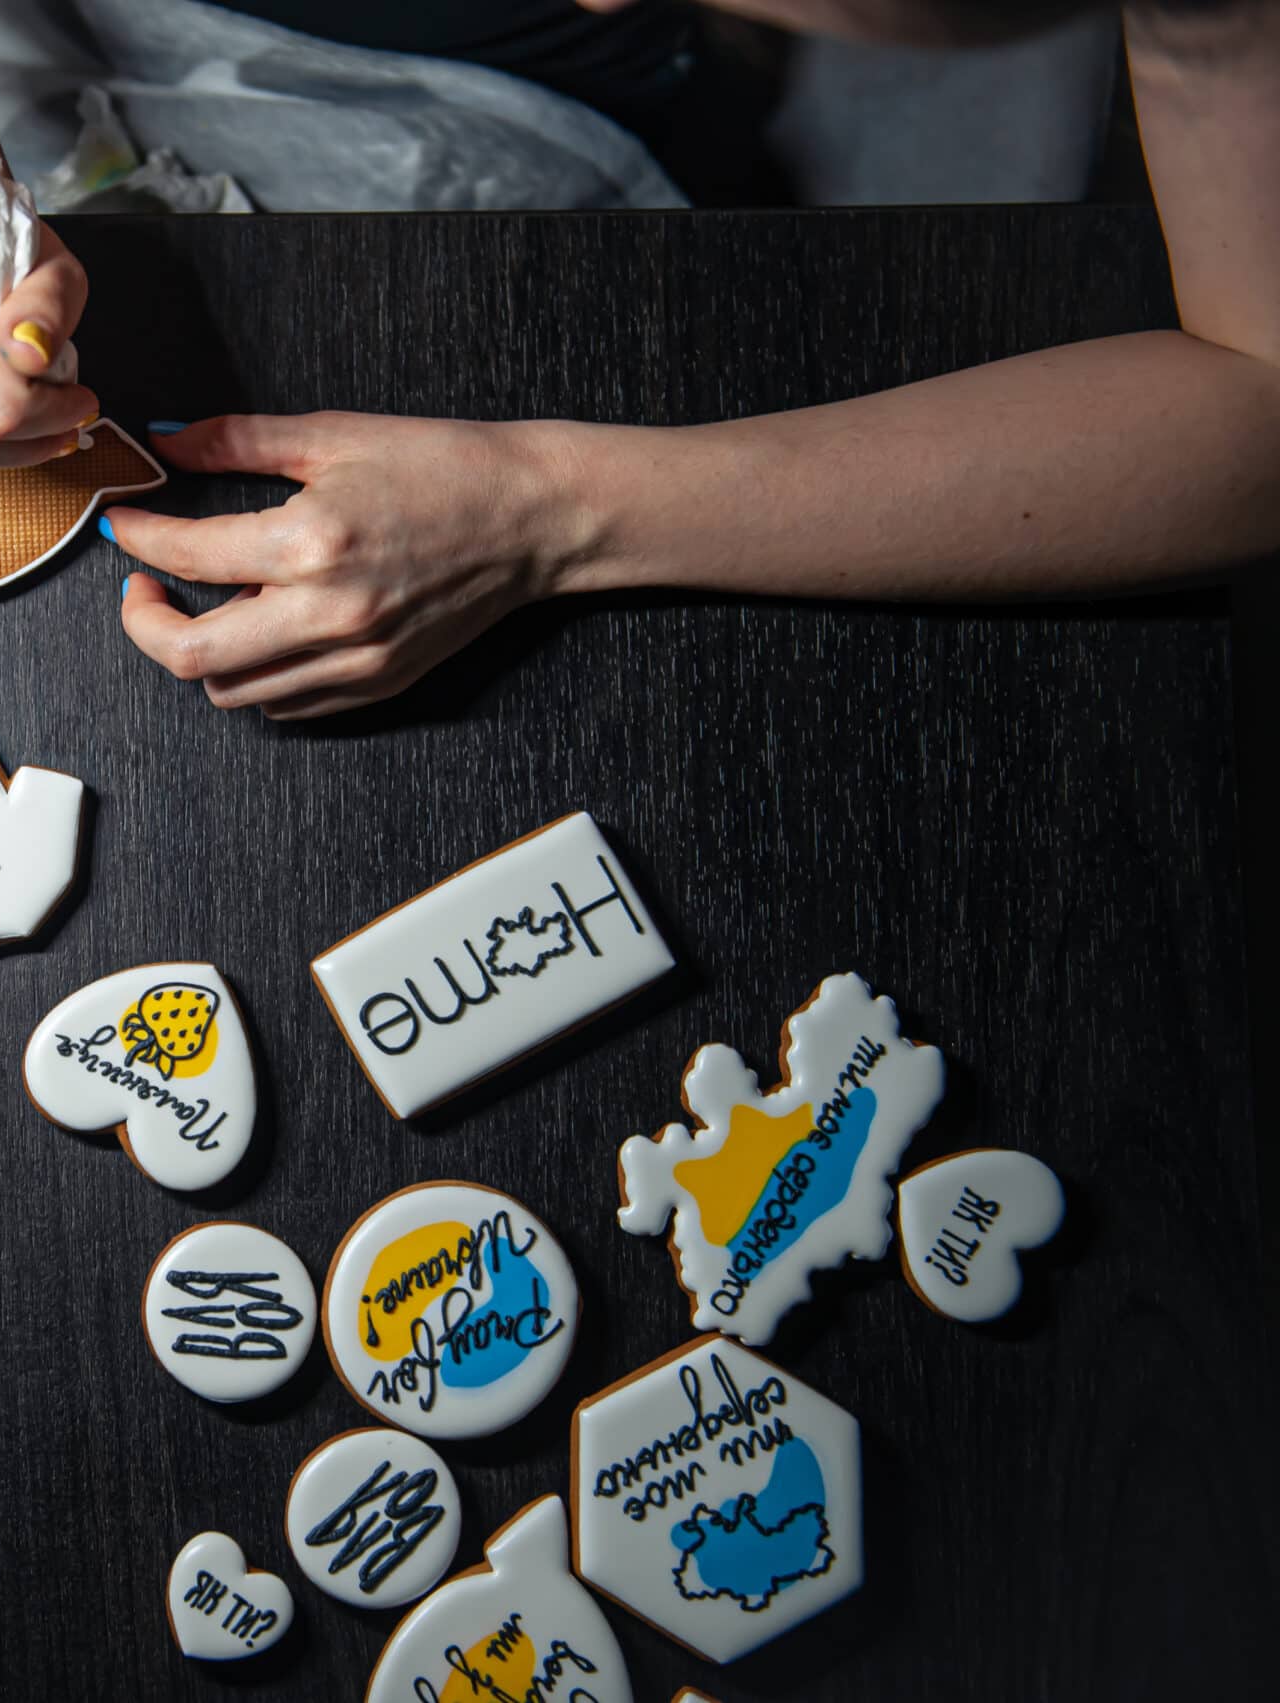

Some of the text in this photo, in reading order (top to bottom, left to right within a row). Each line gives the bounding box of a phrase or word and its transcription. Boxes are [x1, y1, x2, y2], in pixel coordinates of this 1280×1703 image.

[55, 1025, 228, 1151] Паляниця
[710, 1035, 887, 1317] ти моє серденько
[924, 1187, 1001, 1287] ЯК ТИ?
[361, 1210, 537, 1347] Ukraine!
[366, 1277, 564, 1412] Pray for
[593, 1353, 788, 1498] серденько
[623, 1417, 794, 1521] ти моє
[183, 1569, 278, 1648] ЯК ТИ?
